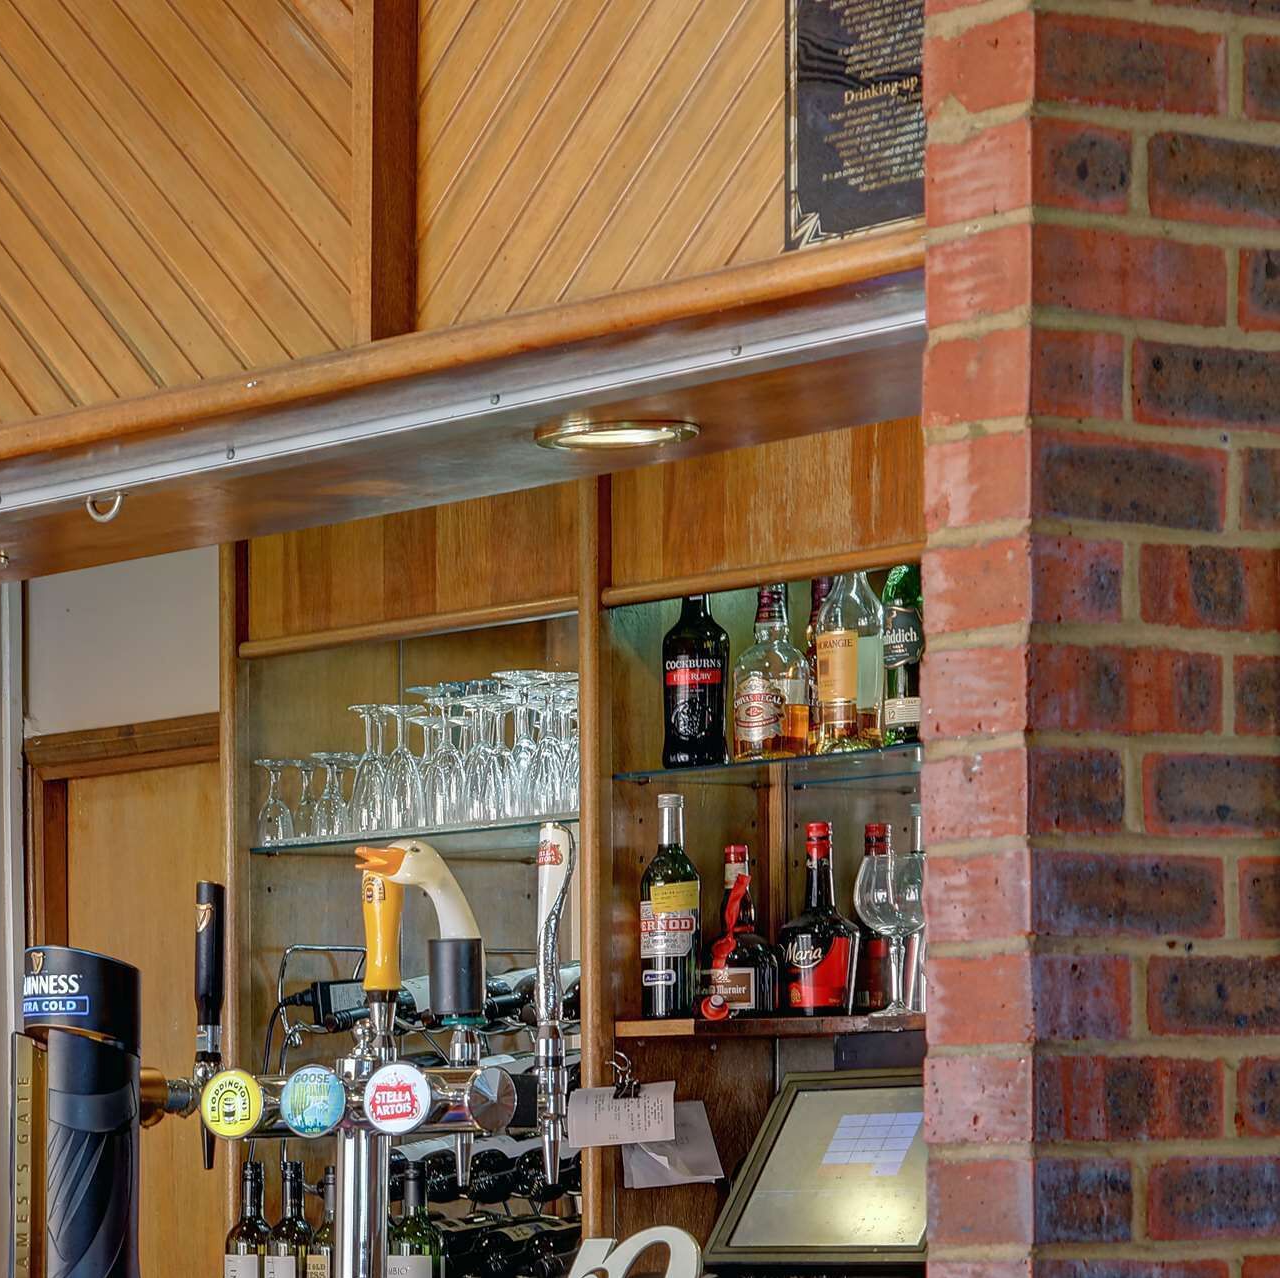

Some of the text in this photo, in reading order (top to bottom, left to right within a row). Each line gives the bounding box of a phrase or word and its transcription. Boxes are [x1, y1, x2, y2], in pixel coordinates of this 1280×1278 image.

[844, 76, 918, 105] Drinking-up
[756, 693, 782, 705] REGAL
[887, 710, 897, 721] 12
[641, 919, 691, 932] ERNOD
[784, 942, 822, 961] Maria
[23, 974, 80, 995] UINNESS
[42, 1001, 77, 1011] COLD
[294, 1073, 330, 1083] GOOSE
[375, 1091, 411, 1103] STELLA
[17, 1077, 31, 1145] GATE
[375, 1103, 411, 1116] ARTOIS
